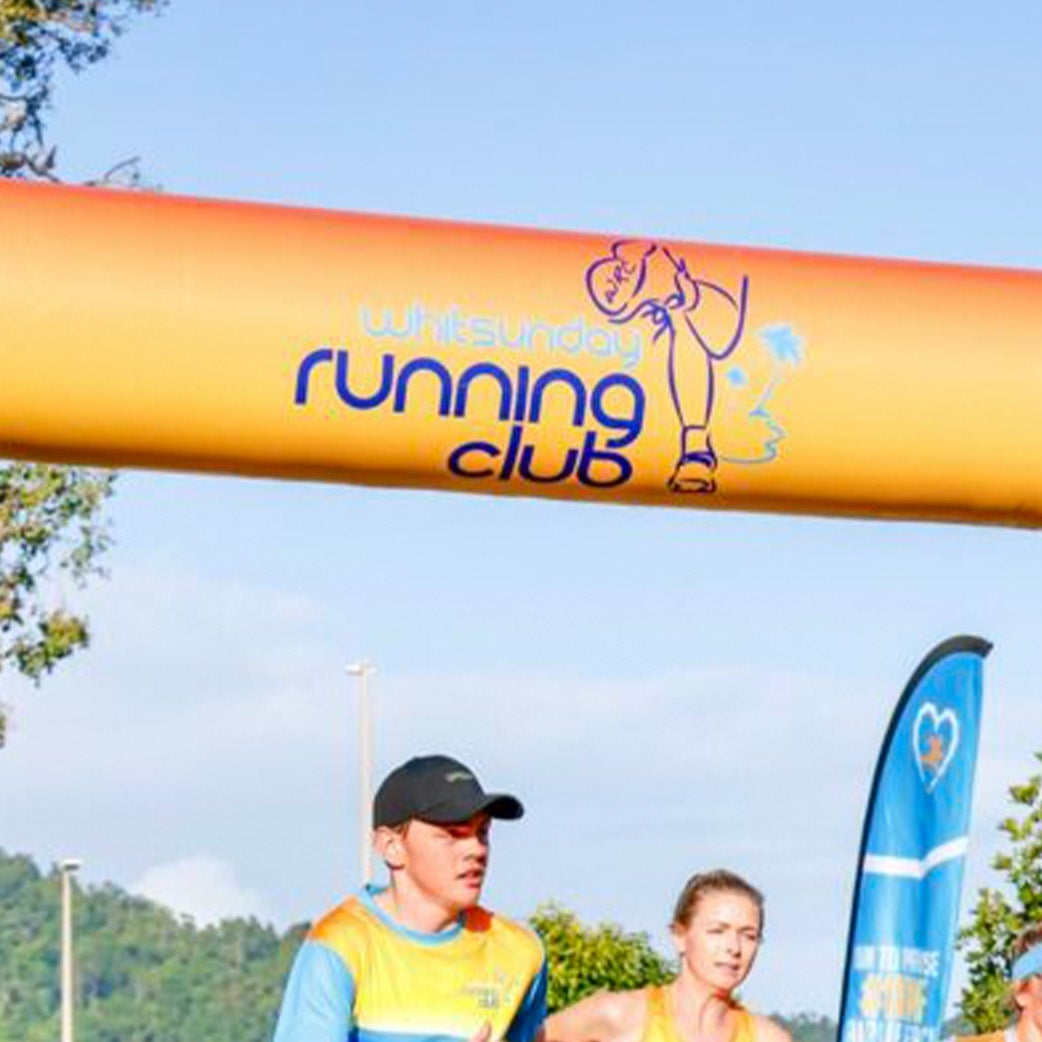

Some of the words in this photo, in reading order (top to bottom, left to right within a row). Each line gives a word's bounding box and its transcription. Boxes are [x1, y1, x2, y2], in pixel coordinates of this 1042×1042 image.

[361, 303, 643, 367] whitsunday
[294, 347, 646, 449] running
[447, 425, 633, 488] club
